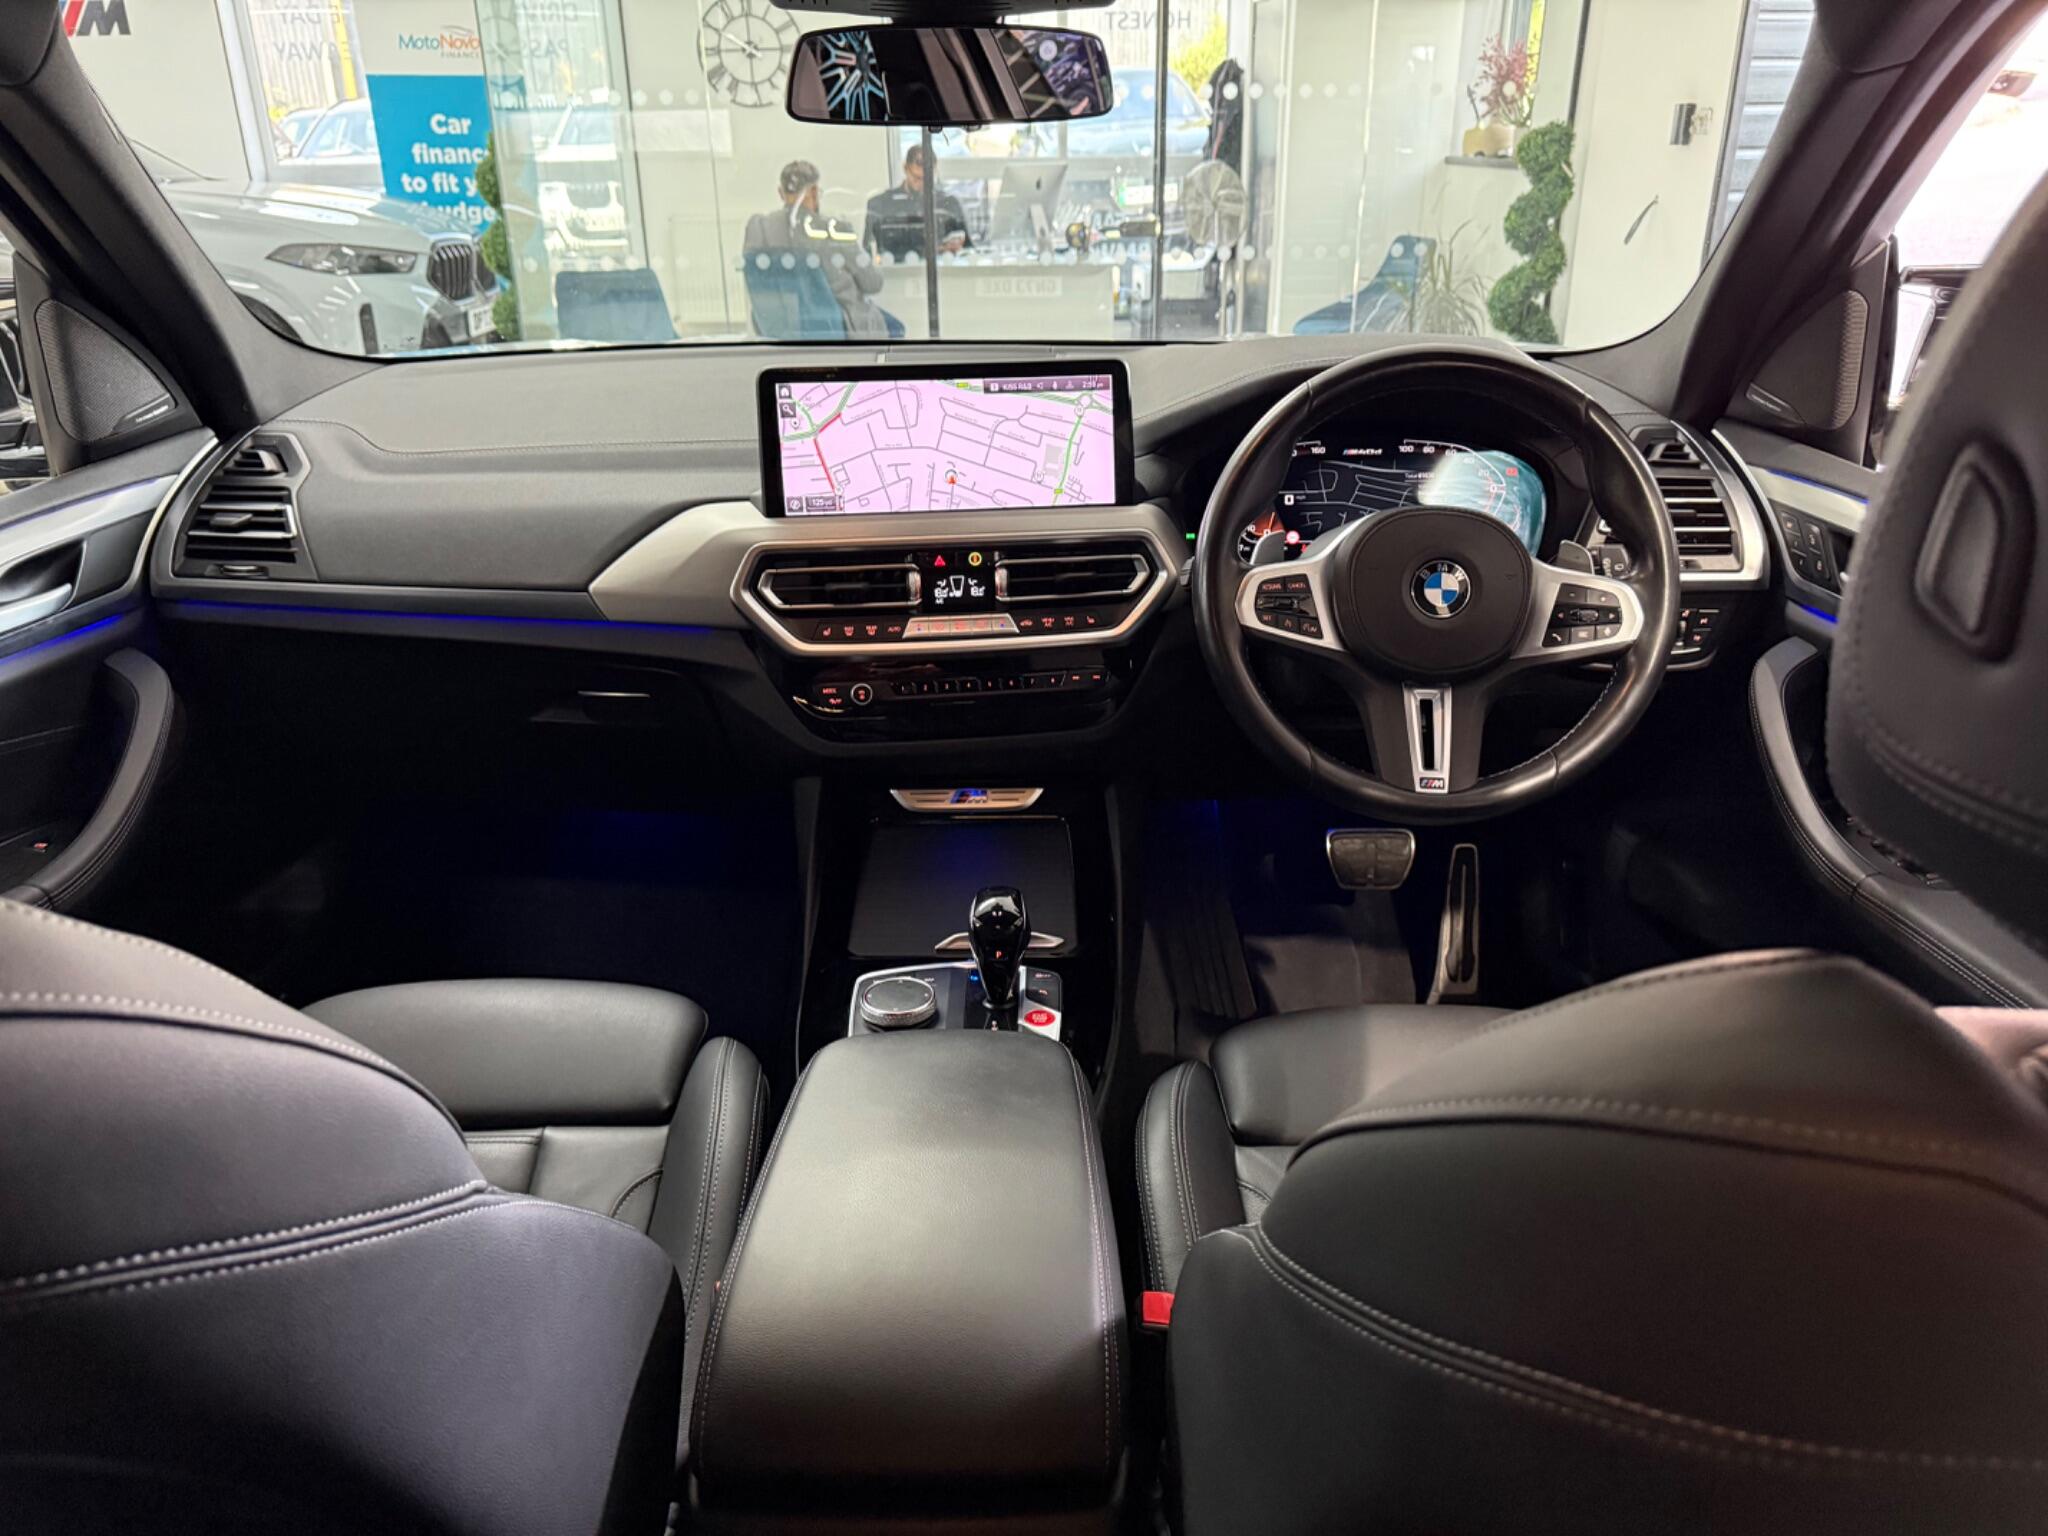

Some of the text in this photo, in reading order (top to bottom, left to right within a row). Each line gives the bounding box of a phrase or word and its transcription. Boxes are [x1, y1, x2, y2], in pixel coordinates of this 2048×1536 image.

[399, 33, 480, 51] MotoNovo
[430, 113, 472, 135] Car
[411, 142, 489, 164] financ
[401, 173, 428, 193] to
[432, 172, 460, 193] fit
[1284, 495, 1294, 505] 0
[1420, 562, 1466, 581] BMW
